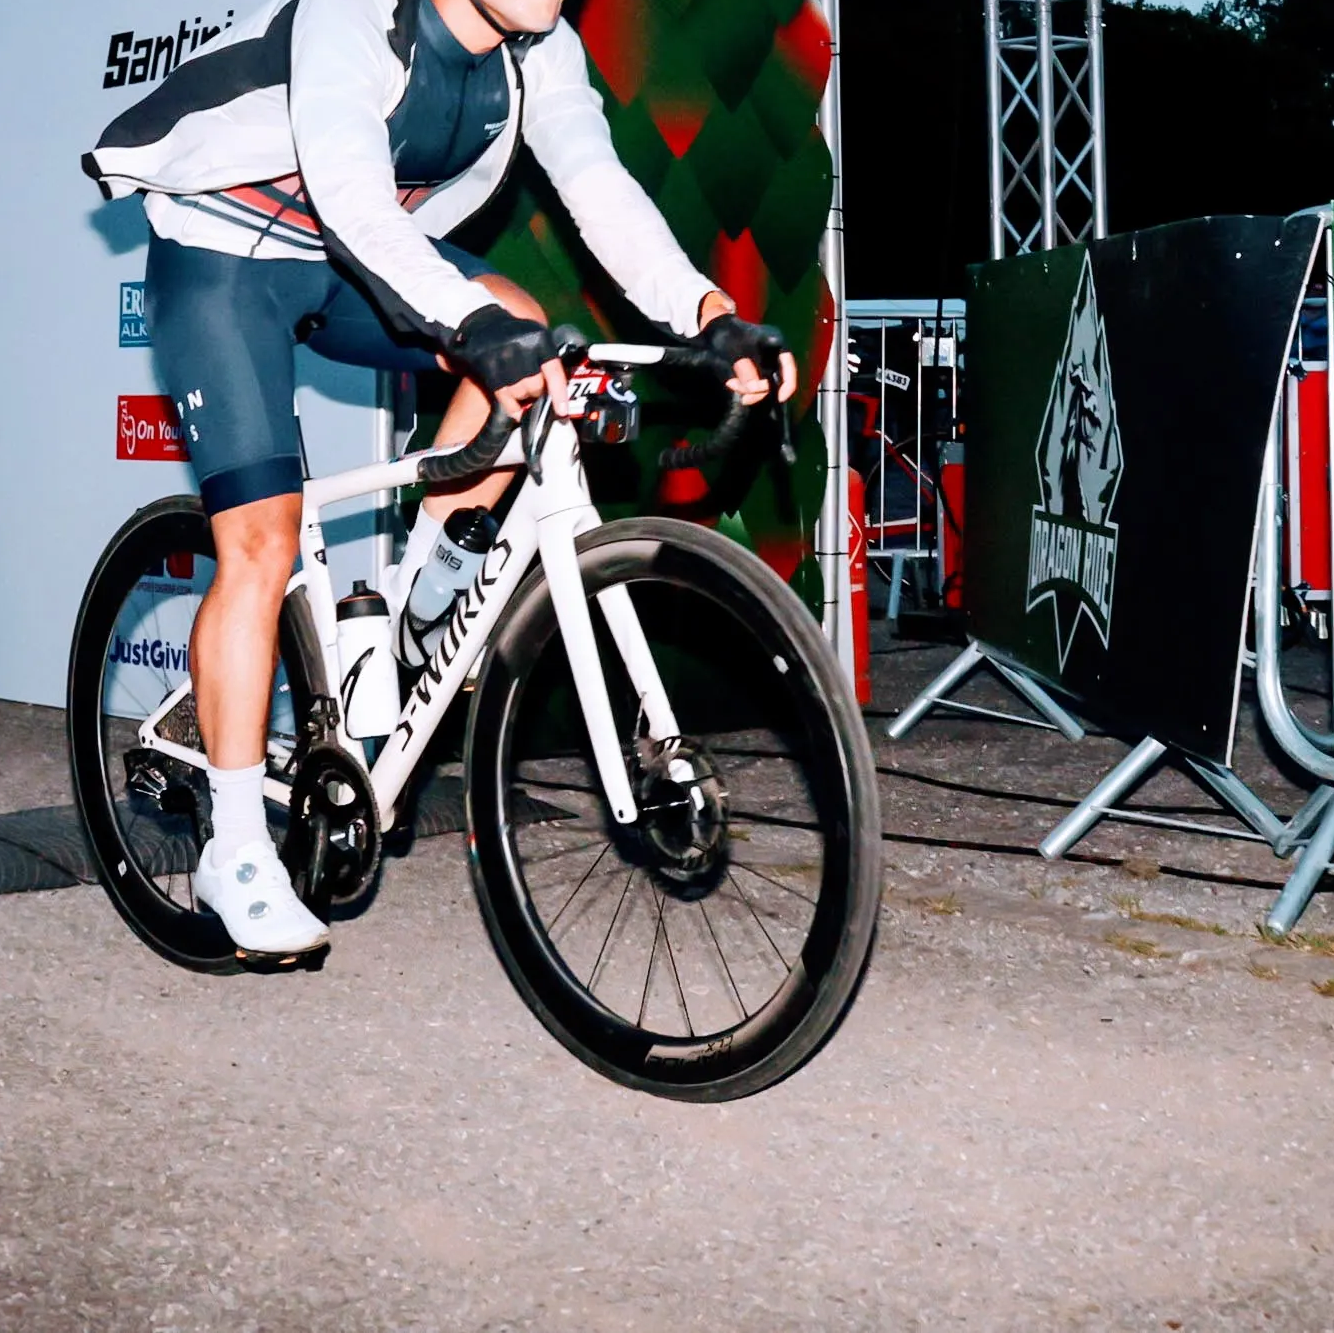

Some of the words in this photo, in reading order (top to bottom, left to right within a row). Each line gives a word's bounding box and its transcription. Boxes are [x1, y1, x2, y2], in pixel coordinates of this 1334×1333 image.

[103, 10, 234, 89] Santi
[137, 420, 155, 440] On
[1031, 519, 1082, 590] DRAGON
[1082, 531, 1115, 620] RIDE
[395, 537, 512, 752] S-WORKS
